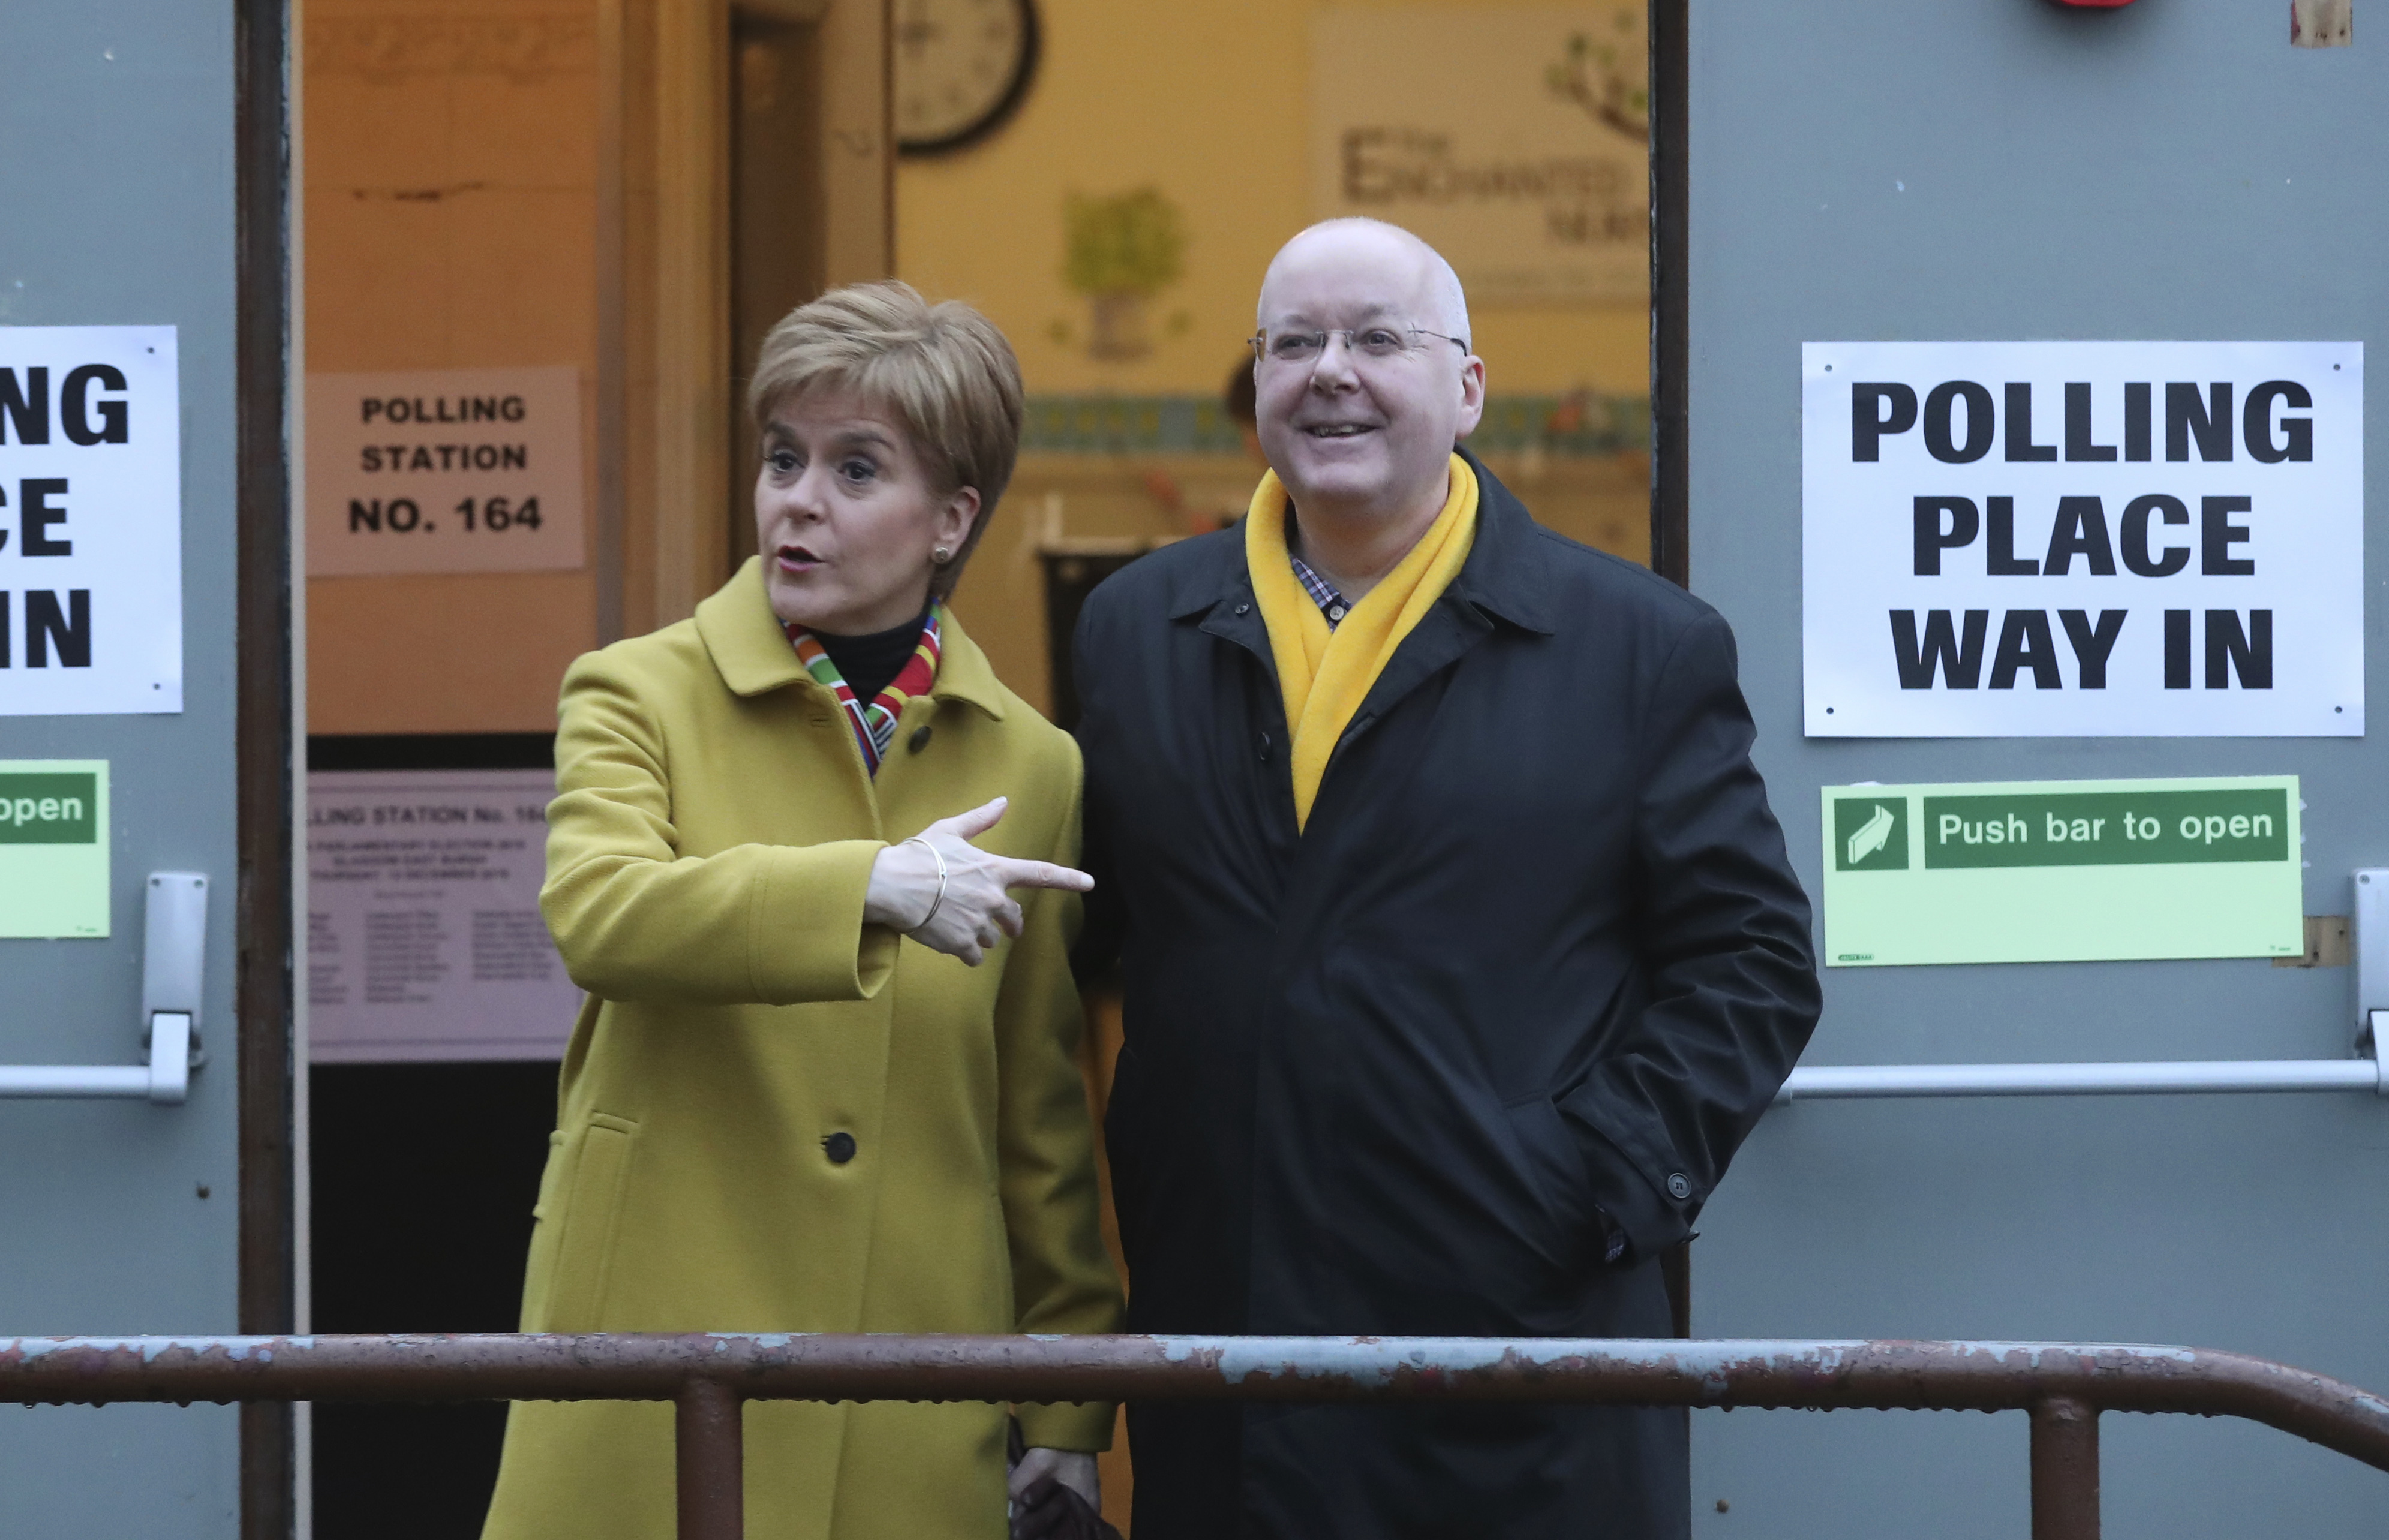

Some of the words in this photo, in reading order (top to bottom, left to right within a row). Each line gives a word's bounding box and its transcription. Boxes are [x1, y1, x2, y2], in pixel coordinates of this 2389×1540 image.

[0, 364, 128, 446] NG
[361, 396, 526, 424] POLLING
[1852, 380, 2313, 464] POLLING
[361, 444, 527, 473] STATION
[0, 478, 73, 557] E
[348, 497, 437, 534] NO.
[455, 496, 542, 532] 164
[1913, 493, 2255, 579] PLACE
[1889, 609, 2129, 690] WAY
[2164, 609, 2273, 690] IN
[1940, 814, 2027, 844] Push
[2047, 813, 2105, 843] bar
[2124, 811, 2160, 841] to
[2180, 814, 2273, 845] open
